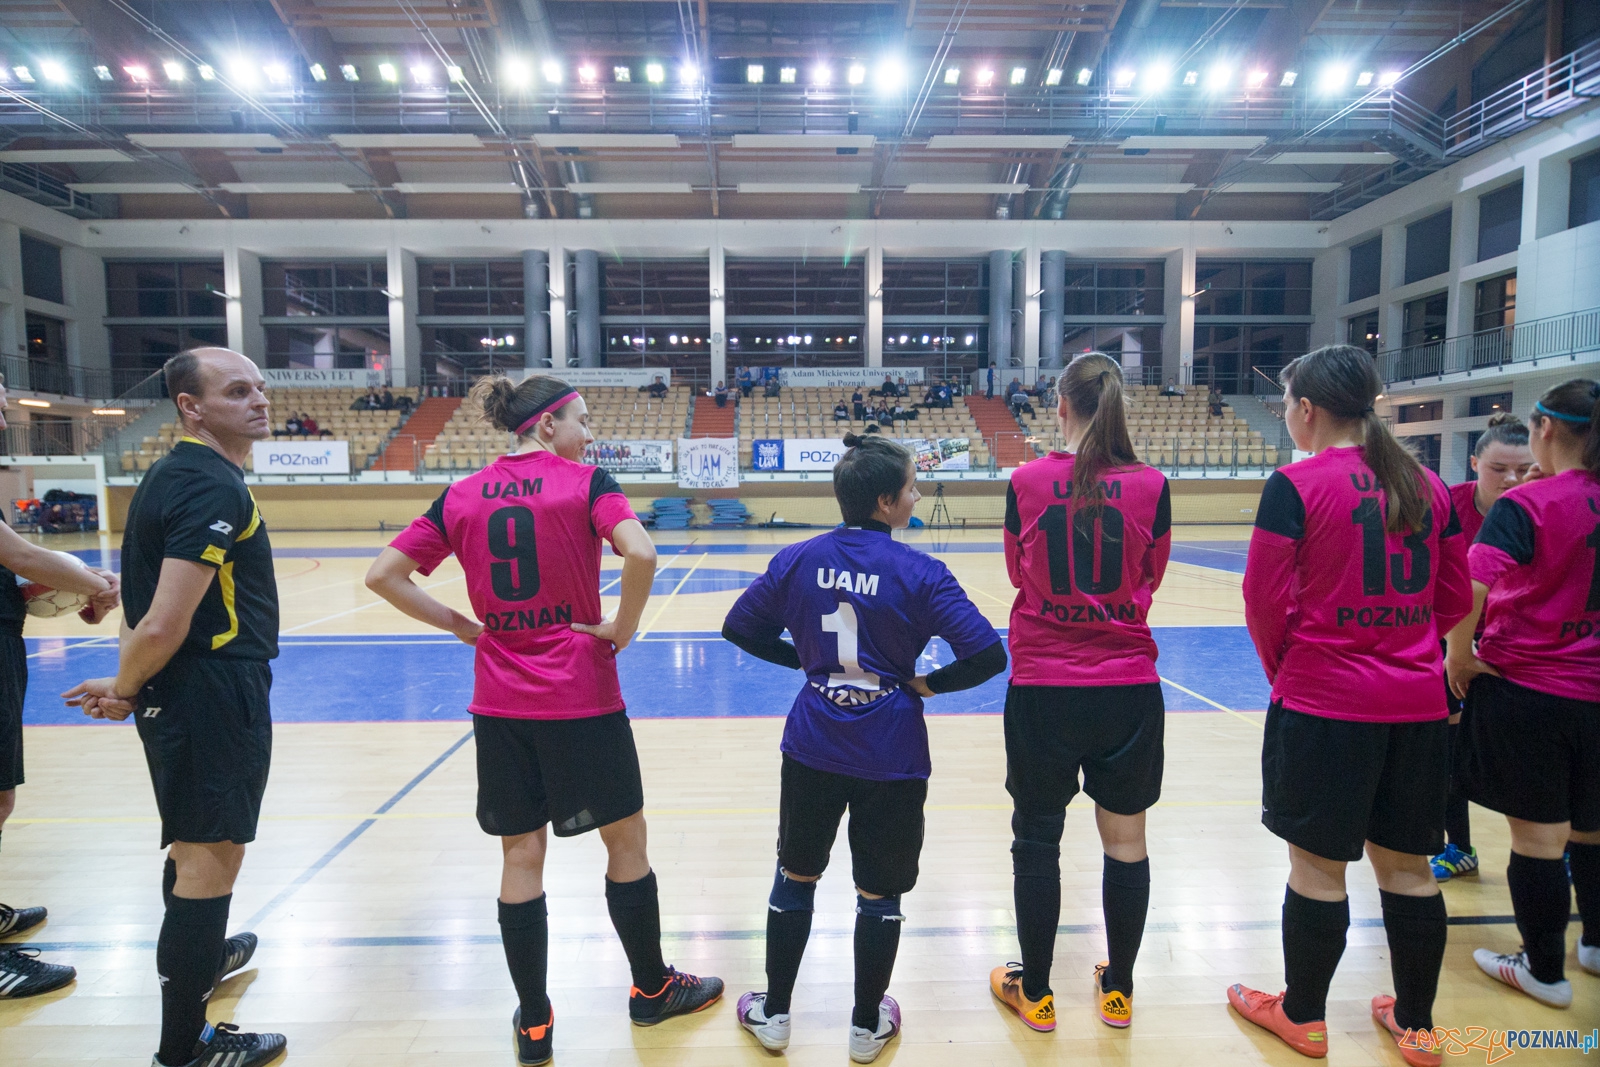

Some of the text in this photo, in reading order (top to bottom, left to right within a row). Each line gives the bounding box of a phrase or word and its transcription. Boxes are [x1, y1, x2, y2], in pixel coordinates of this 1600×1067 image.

[264, 371, 355, 380] NIWERSYTET
[791, 369, 902, 378] Adam Mickiewicz University
[690, 454, 721, 477] UAM
[800, 451, 842, 462] POZn
[482, 477, 543, 500] UAM
[487, 505, 541, 602] 9
[1037, 504, 1125, 596] 10
[1351, 497, 1433, 597] 13
[816, 567, 880, 596] UAM
[485, 600, 572, 632] OZNAŃ
[1039, 599, 1136, 623] POZNAŃ
[821, 601, 881, 691] 1
[1103, 1004, 1129, 1016] adidas
